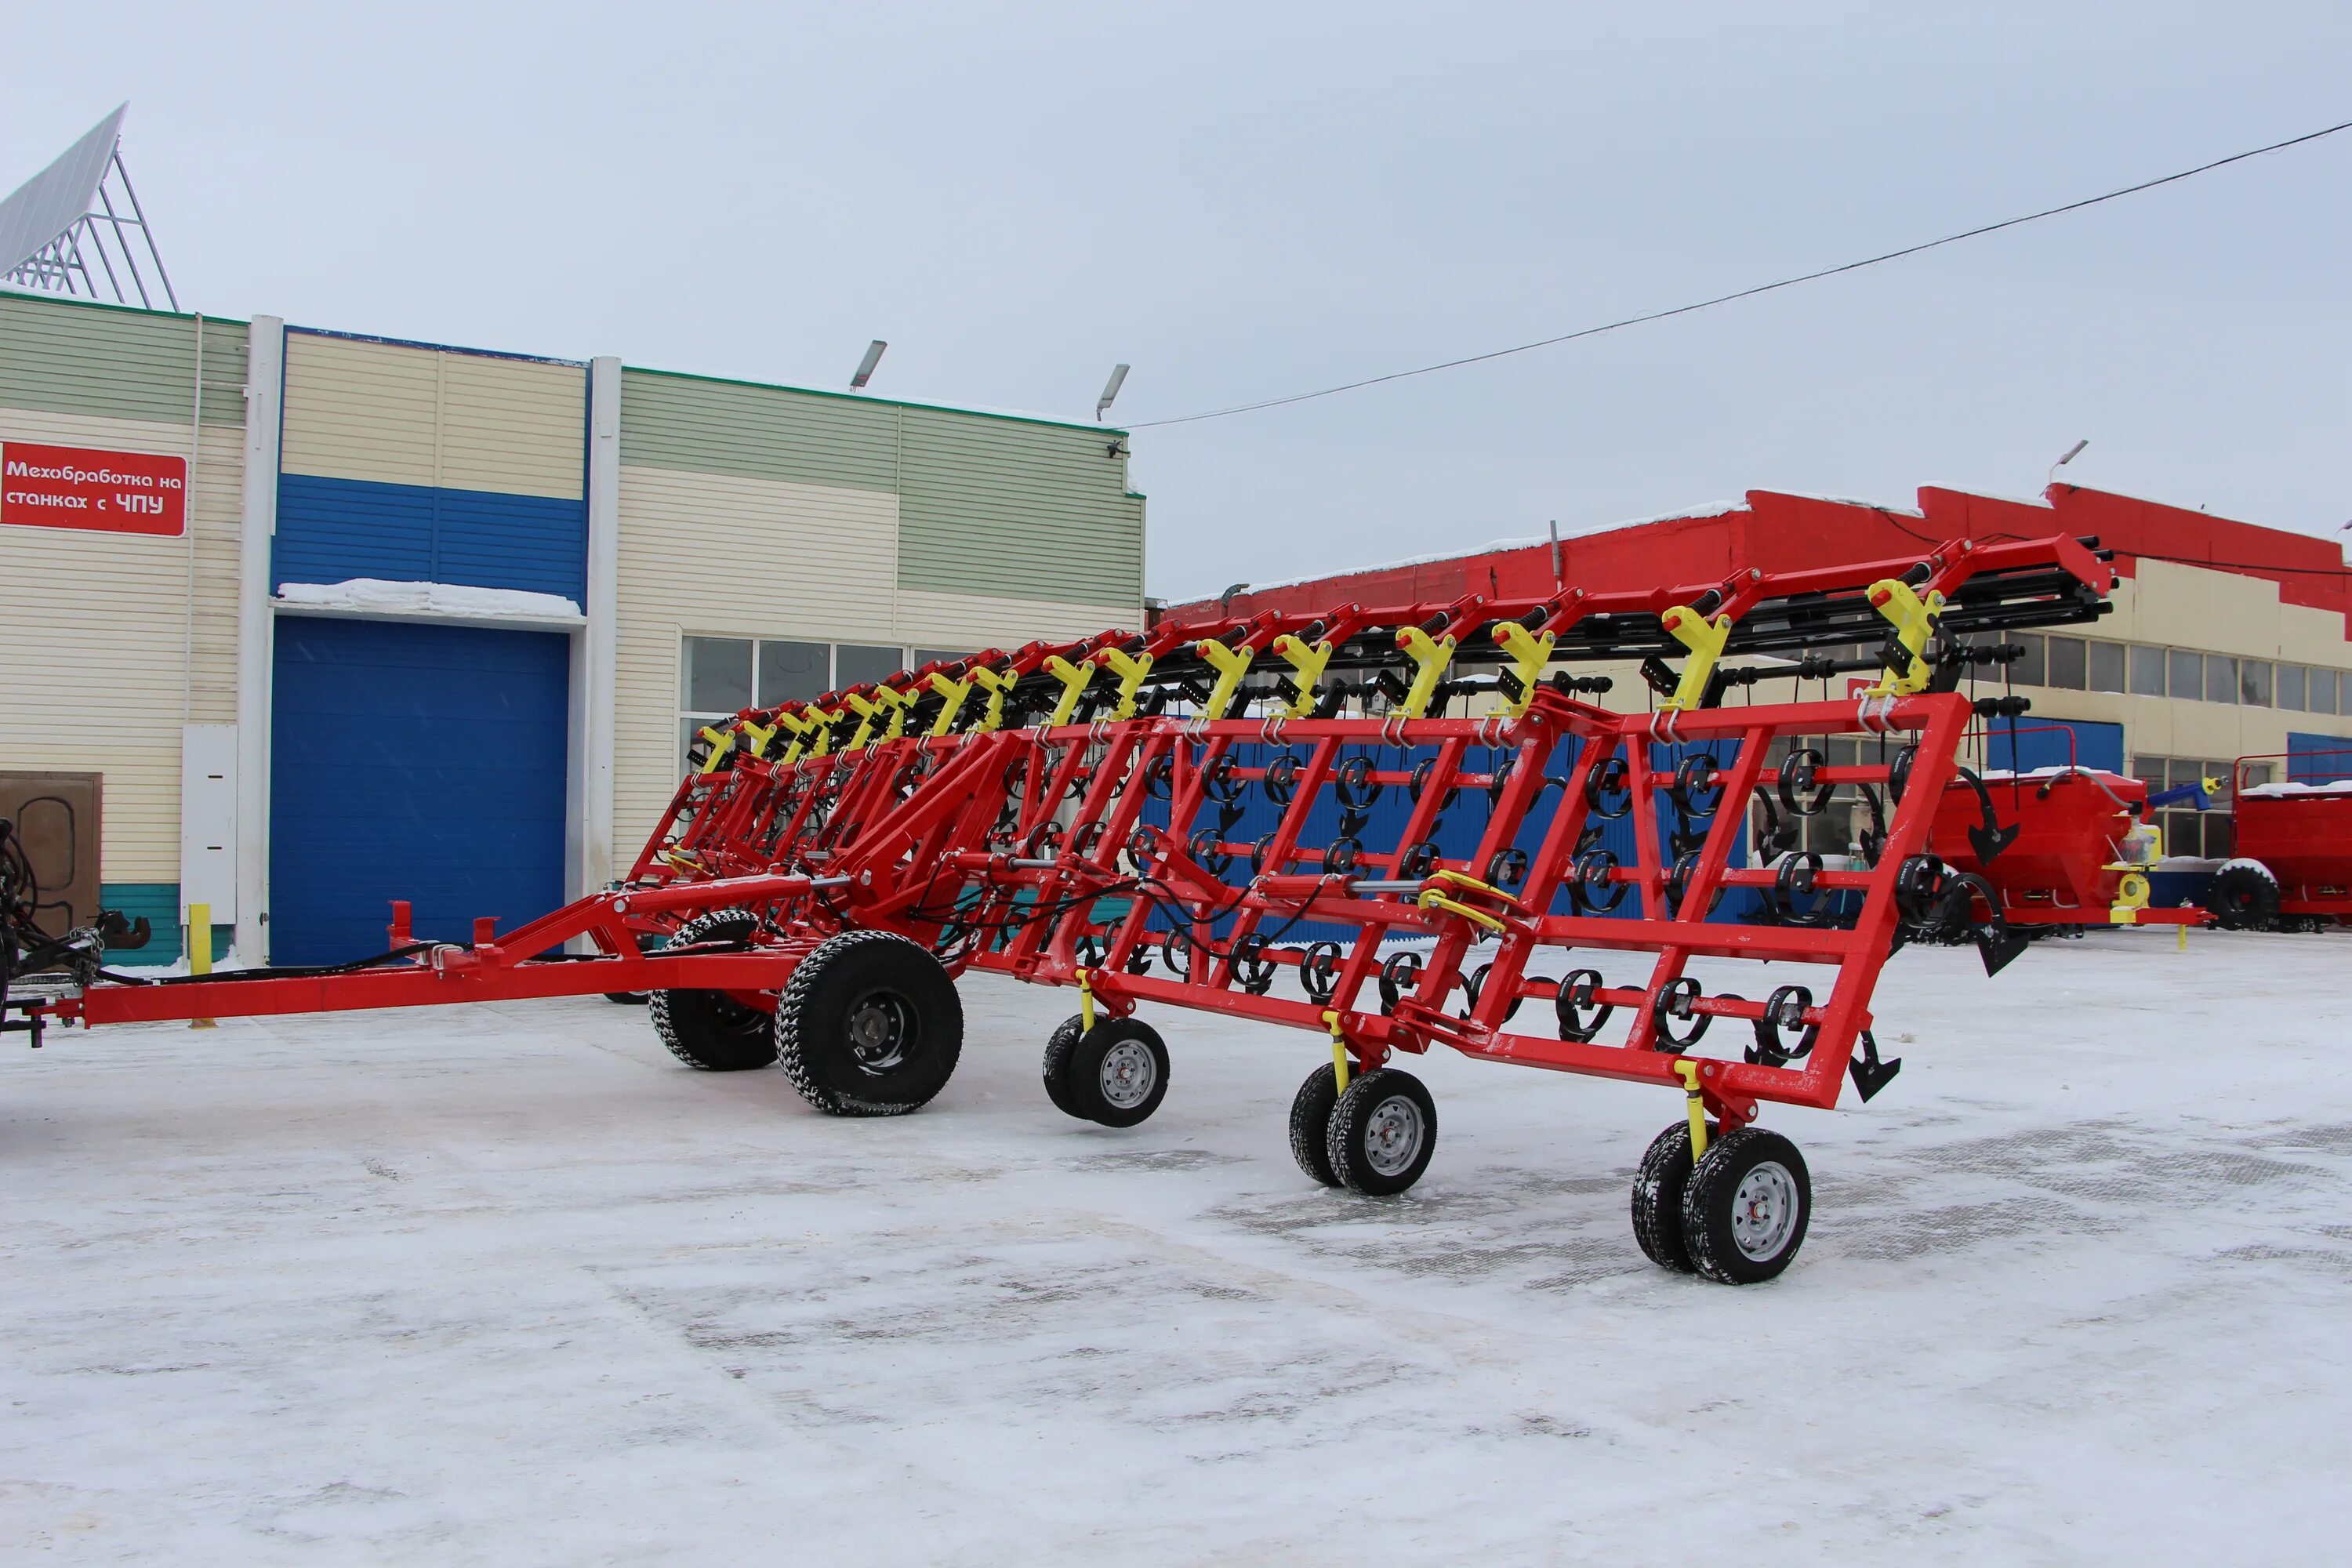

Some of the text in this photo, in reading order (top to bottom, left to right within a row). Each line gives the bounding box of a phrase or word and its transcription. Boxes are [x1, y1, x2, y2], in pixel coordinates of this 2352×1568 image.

[7, 461, 181, 489] Мехобработка на
[6, 492, 163, 514] станках с ЧПУ
